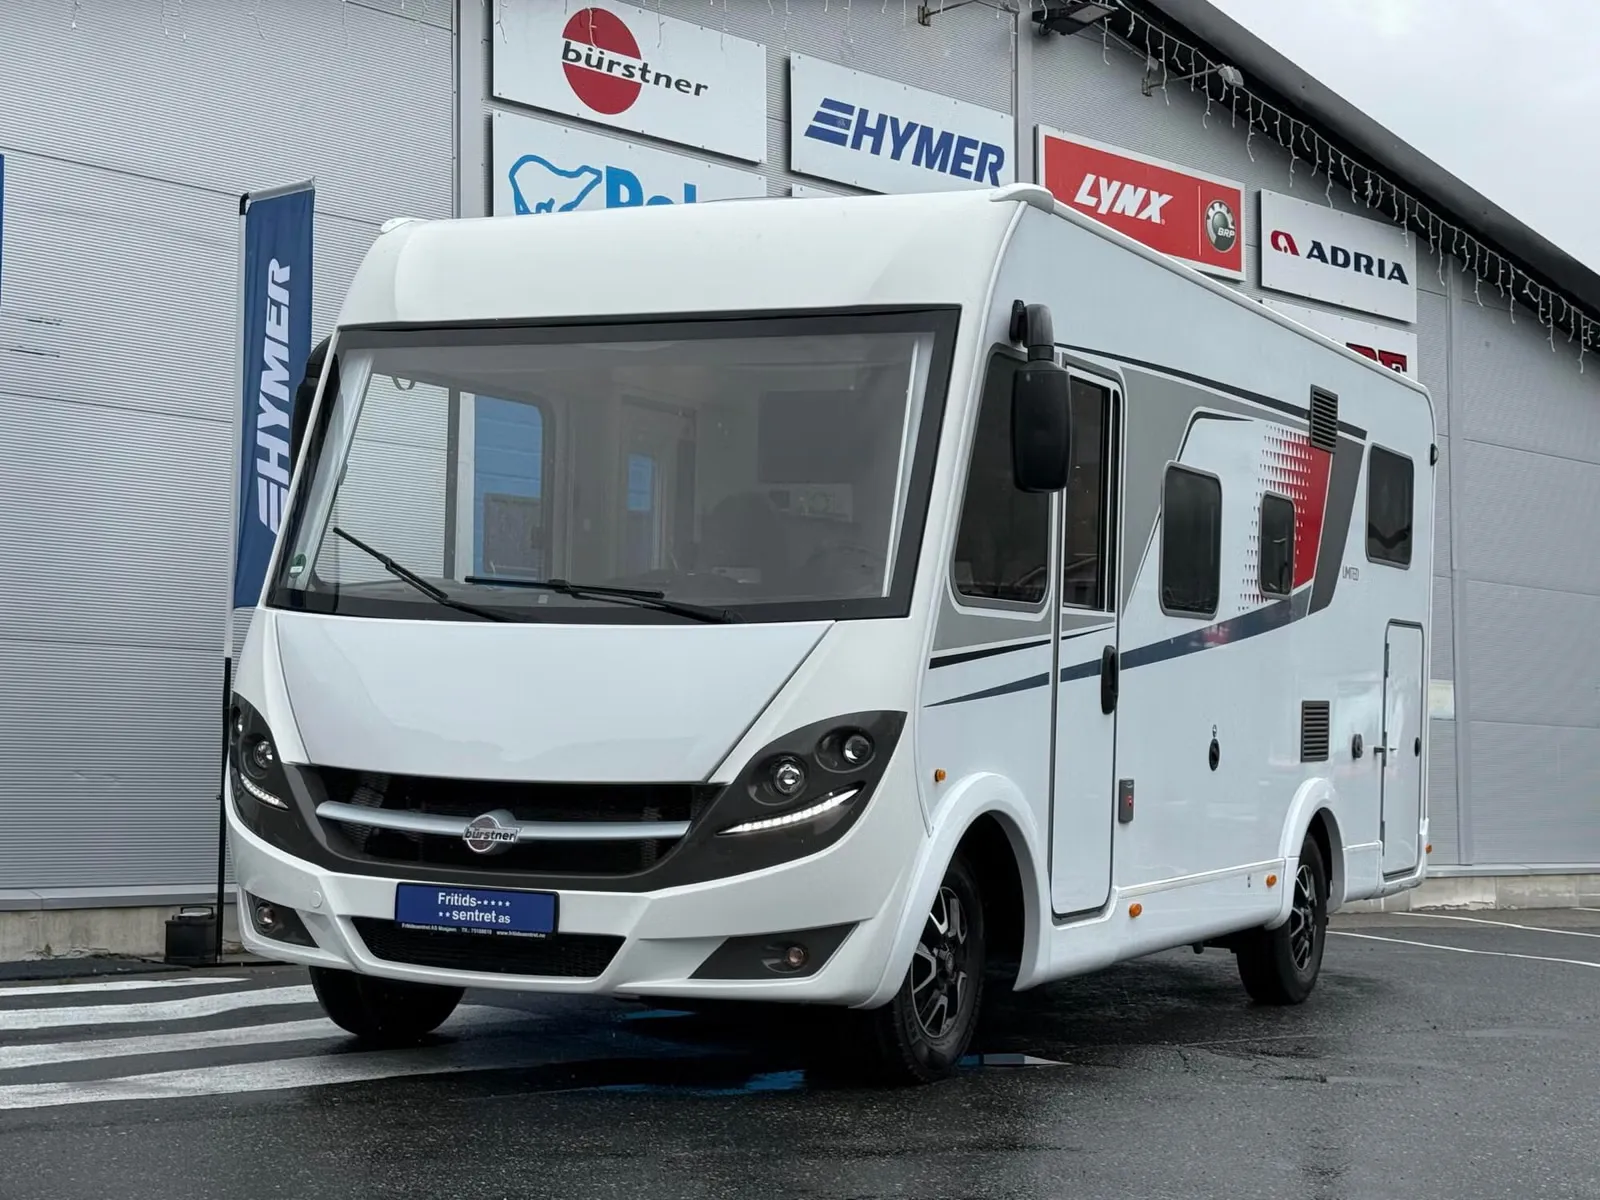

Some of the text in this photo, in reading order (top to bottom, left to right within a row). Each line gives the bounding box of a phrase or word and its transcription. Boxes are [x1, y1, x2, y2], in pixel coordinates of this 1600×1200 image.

[561, 40, 709, 97] bürstner
[850, 107, 1005, 188] HYMER
[1074, 173, 1174, 225] LYNX
[1217, 227, 1236, 239] BRP
[1306, 239, 1410, 286] ADRIA
[256, 257, 291, 486] HYMER
[464, 827, 517, 841] bürstner
[451, 909, 511, 924] sentret as
